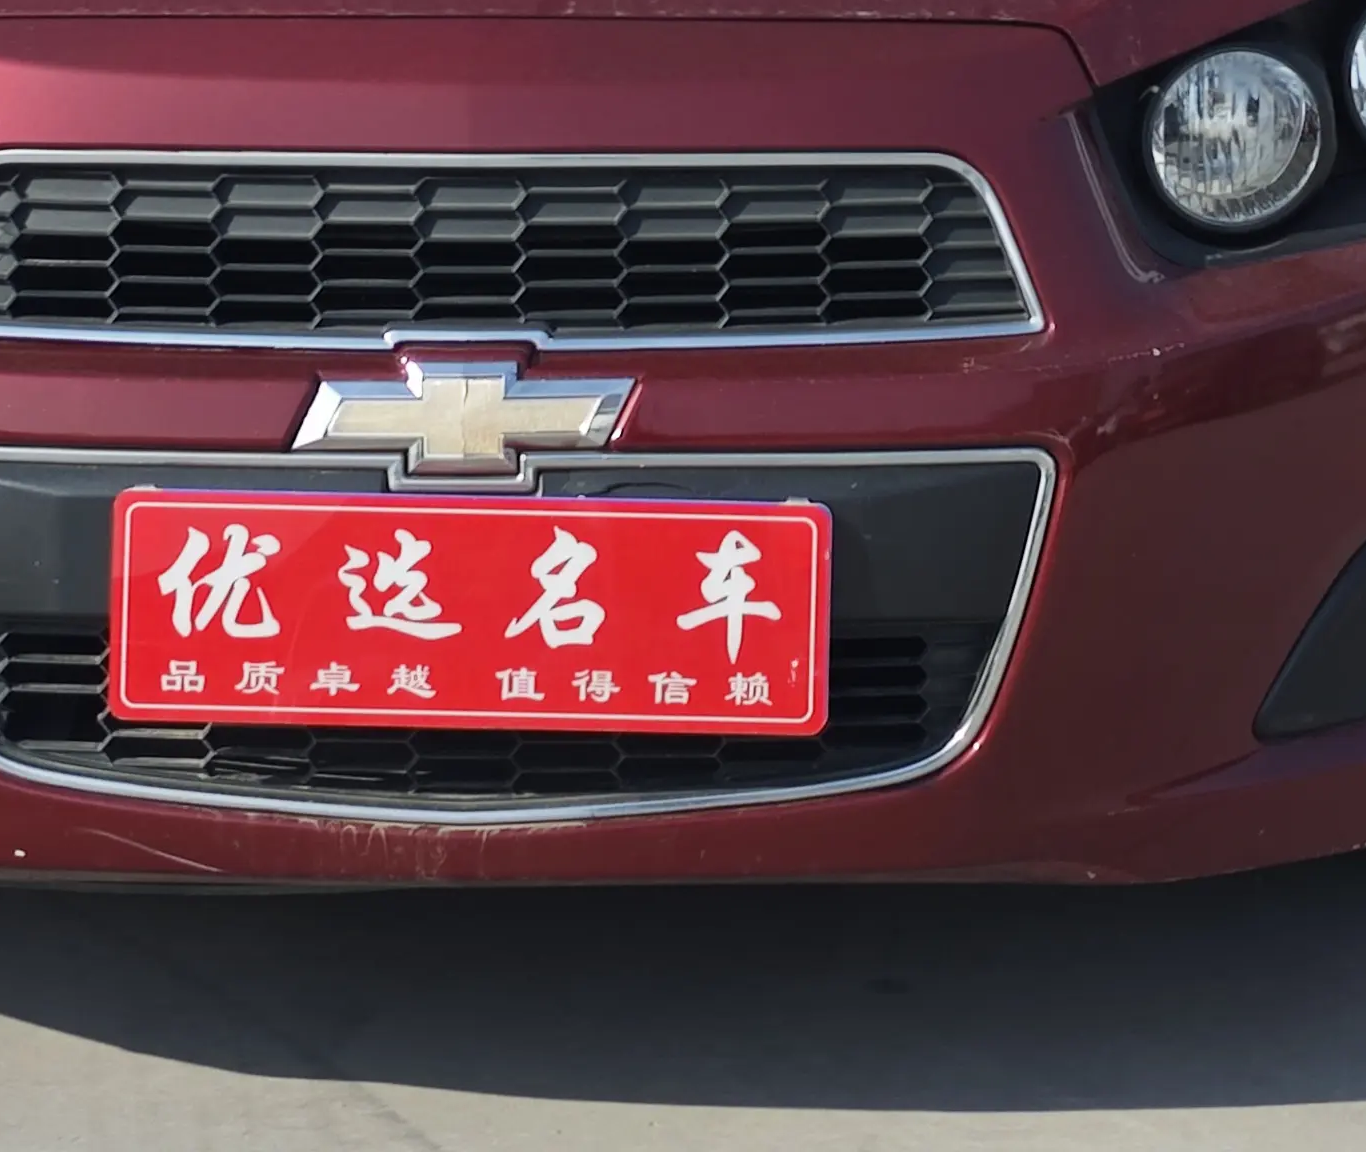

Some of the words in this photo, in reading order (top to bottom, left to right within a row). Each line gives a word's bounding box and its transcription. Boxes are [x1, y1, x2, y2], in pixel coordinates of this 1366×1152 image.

[157, 523, 782, 664] 优选名车
[160, 659, 436, 699] 品质卓越
[495, 667, 773, 706] 值得信赖
